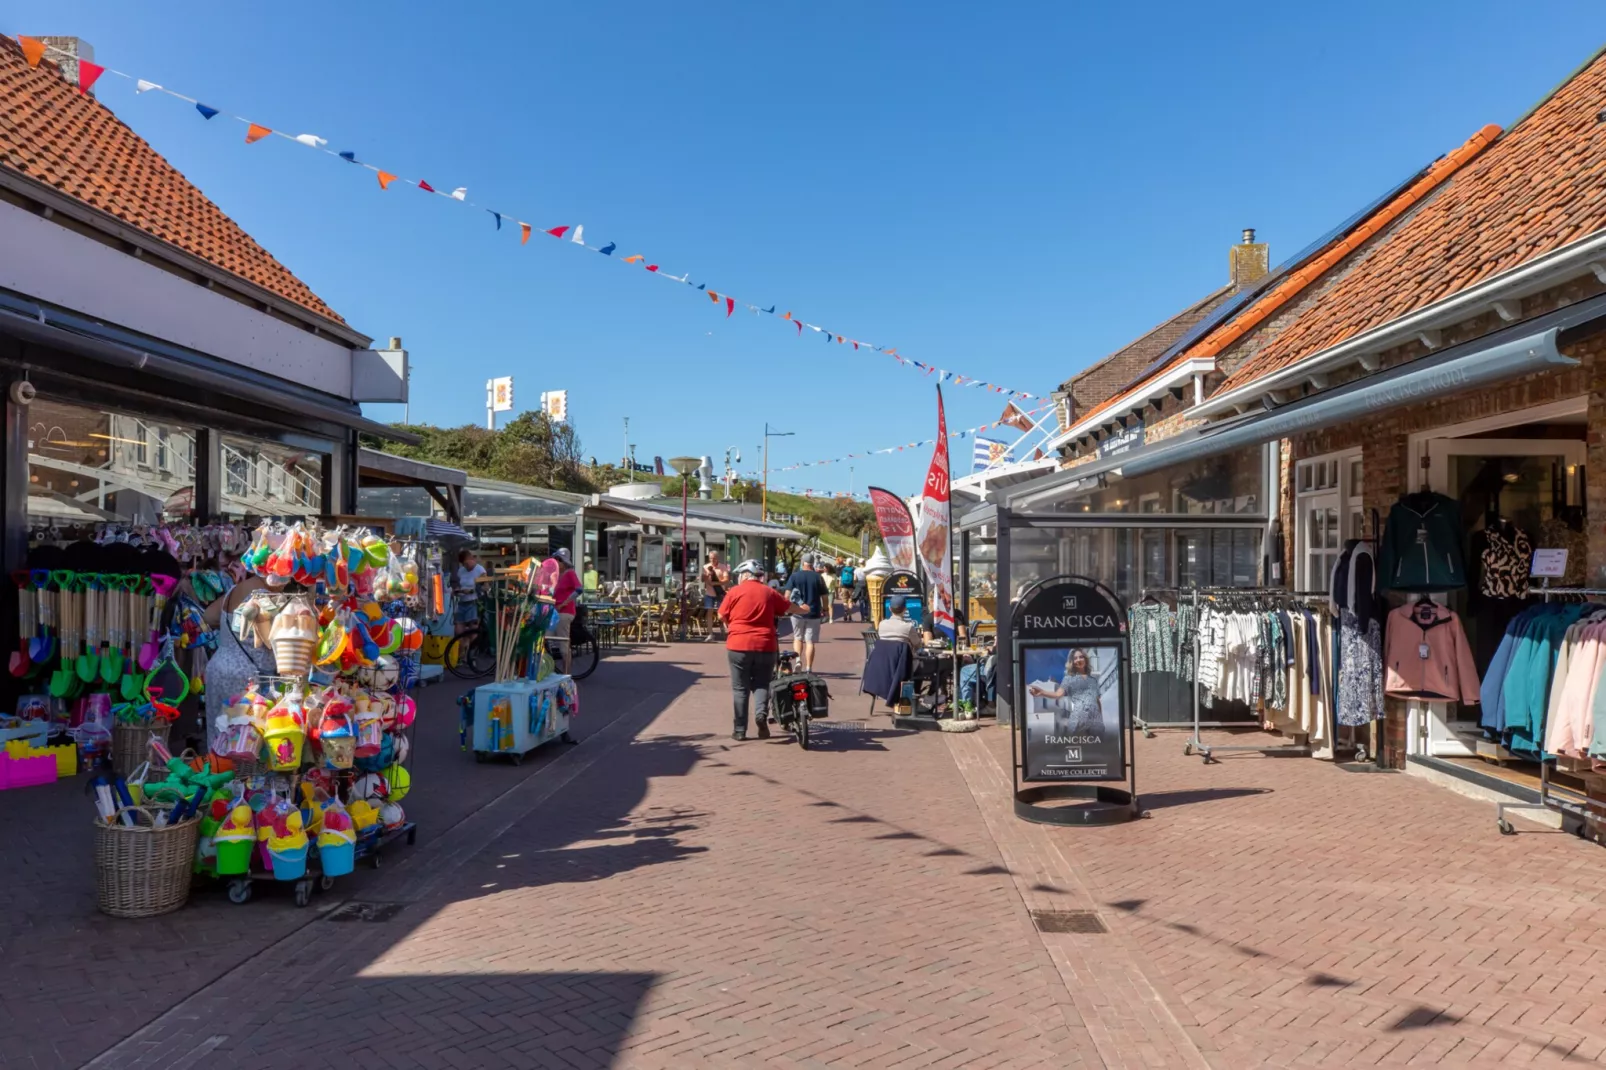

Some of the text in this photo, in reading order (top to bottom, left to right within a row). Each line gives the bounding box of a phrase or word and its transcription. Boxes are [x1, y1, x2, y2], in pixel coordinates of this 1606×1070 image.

[1023, 614, 1115, 629] FRANCISCA
[1044, 734, 1102, 744] FRANCISCA
[1068, 749, 1079, 759] M
[1070, 768, 1108, 776] COLLECTIE
